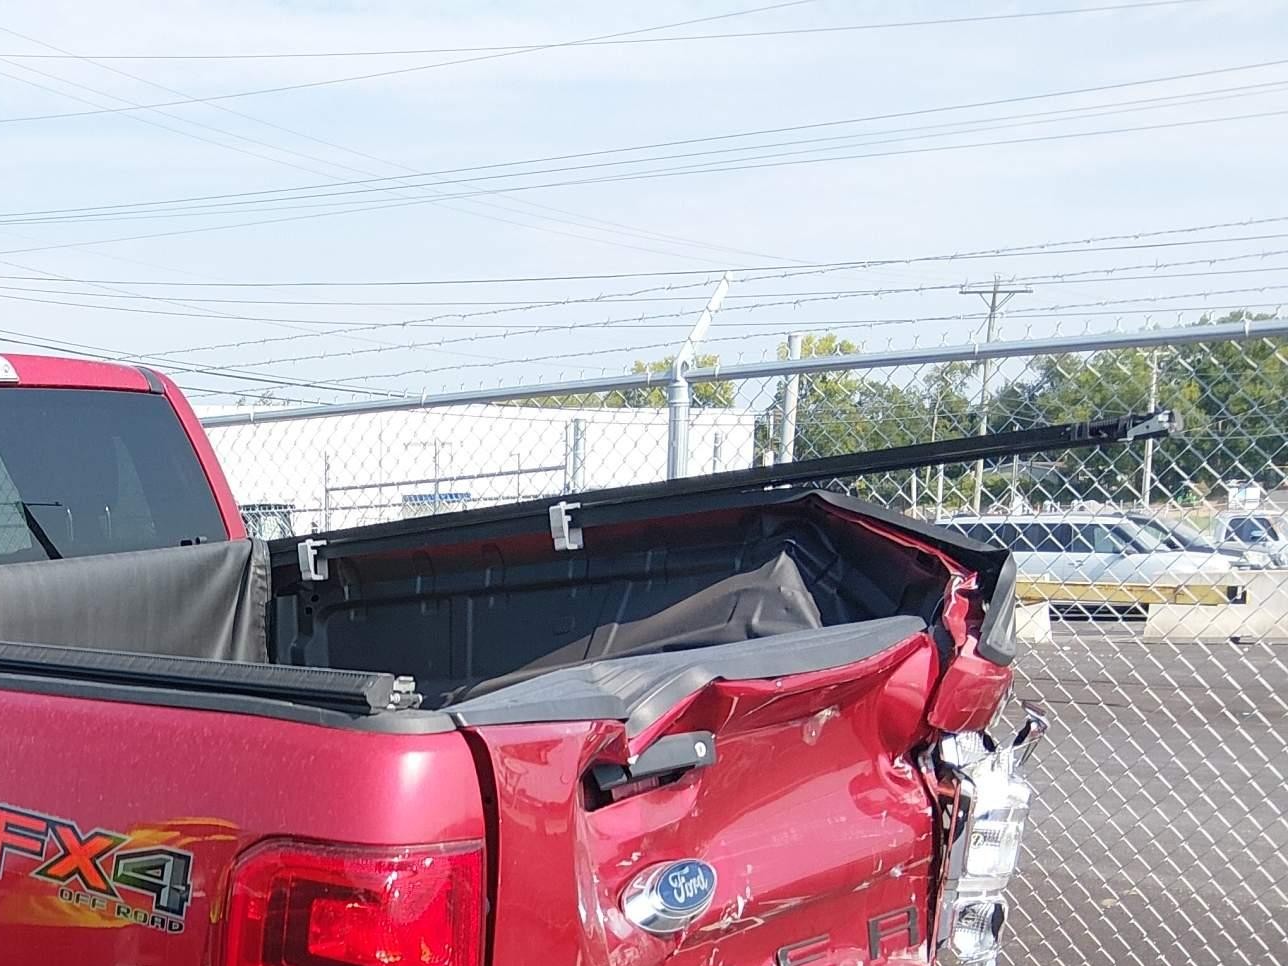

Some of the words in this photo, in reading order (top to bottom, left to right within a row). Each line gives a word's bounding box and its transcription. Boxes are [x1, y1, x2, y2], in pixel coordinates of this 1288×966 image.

[668, 865, 709, 904] Ford
[58, 888, 109, 911] OFF
[115, 902, 186, 935] ROAD
